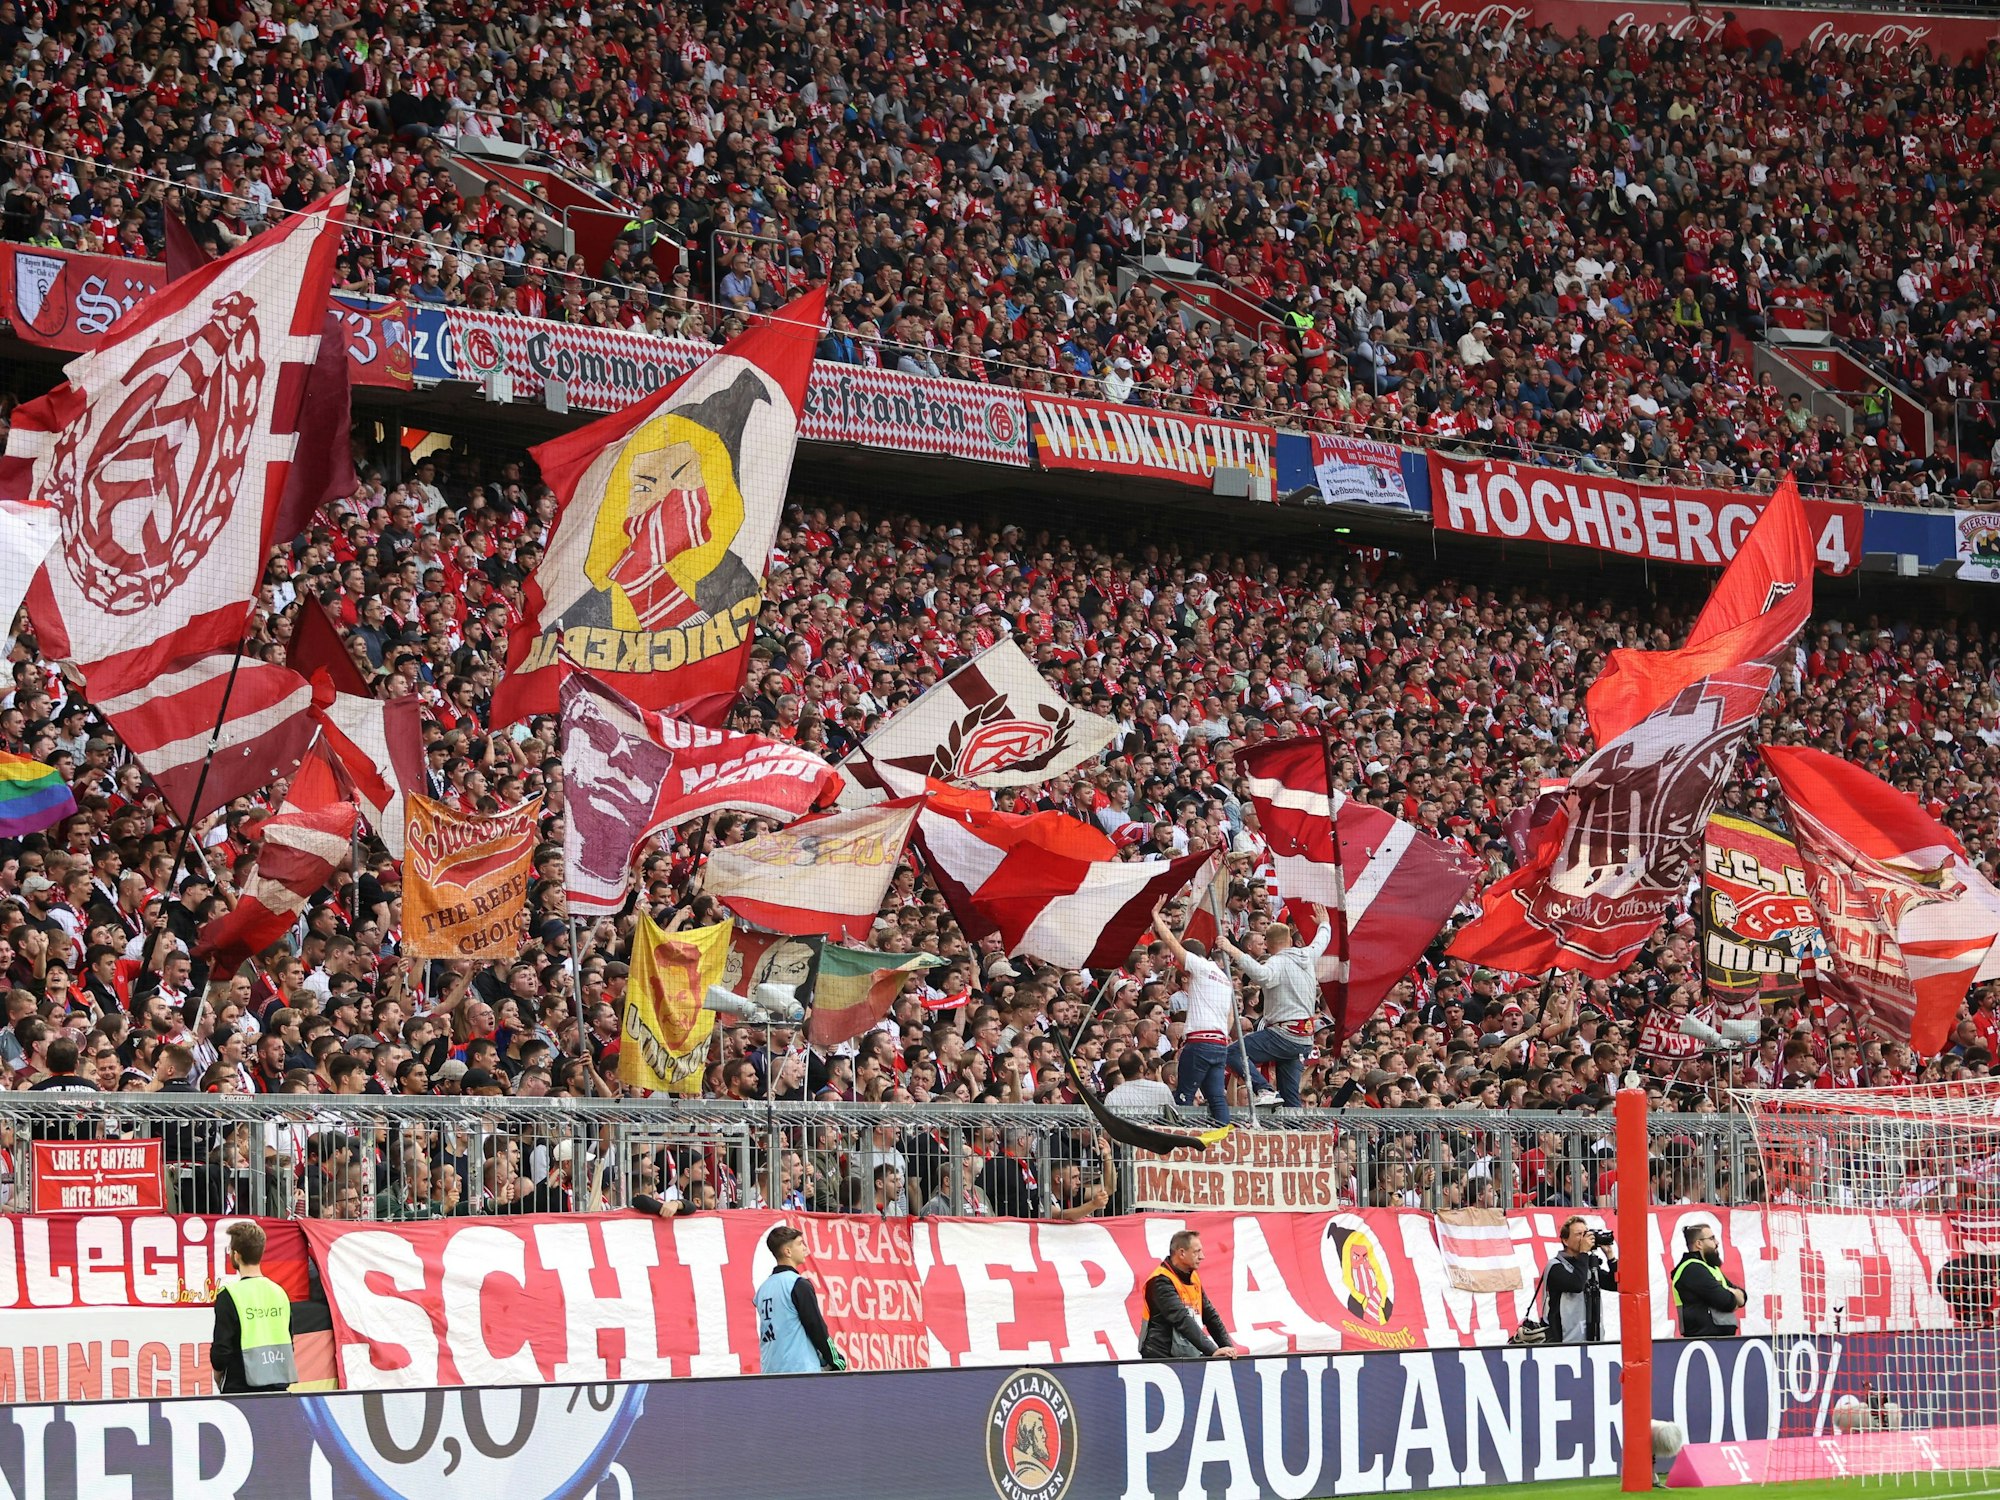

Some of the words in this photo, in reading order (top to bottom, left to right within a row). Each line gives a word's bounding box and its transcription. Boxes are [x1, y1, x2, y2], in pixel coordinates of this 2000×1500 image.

[1030, 400, 1270, 479] WALDKIRCHEN
[1316, 434, 1358, 450] BAYERN
[1361, 441, 1397, 459] POWER
[422, 902, 470, 934] THE
[1639, 1027, 1690, 1056] STOP
[84, 1149, 98, 1170] FC
[101, 1147, 146, 1170] BAYERN
[61, 1186, 91, 1208] HATE
[94, 1185, 138, 1208] RACISM
[1136, 1166, 1225, 1206] IMMER
[1232, 1170, 1275, 1206] BEI
[1282, 1171, 1332, 1206] UNS
[1342, 1319, 1416, 1349] SÜDKURVE
[261, 1350, 286, 1366] 104
[994, 1376, 1069, 1429] PAULANER
[1118, 1345, 1623, 1499] PAULANER
[1001, 1471, 1065, 1500] MÜNCHEN
